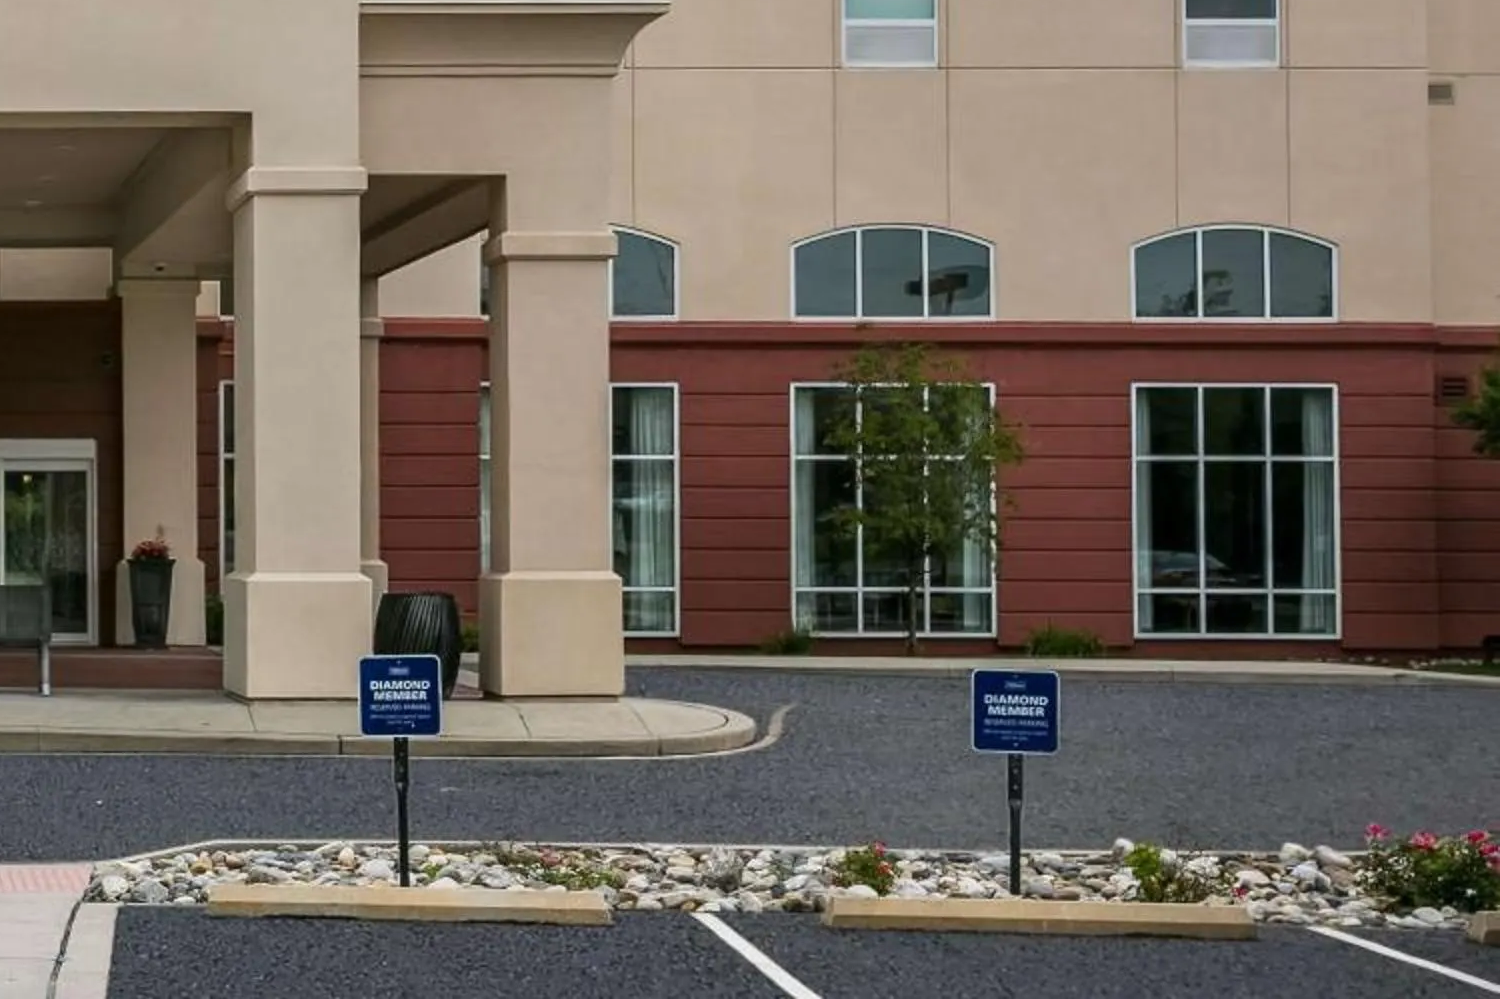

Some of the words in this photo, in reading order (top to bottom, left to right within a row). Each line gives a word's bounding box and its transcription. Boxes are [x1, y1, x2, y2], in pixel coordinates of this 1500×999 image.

[369, 680, 431, 691] DIAMOND
[983, 693, 1049, 706] DIAMOND
[987, 705, 1045, 717] MEMBER
